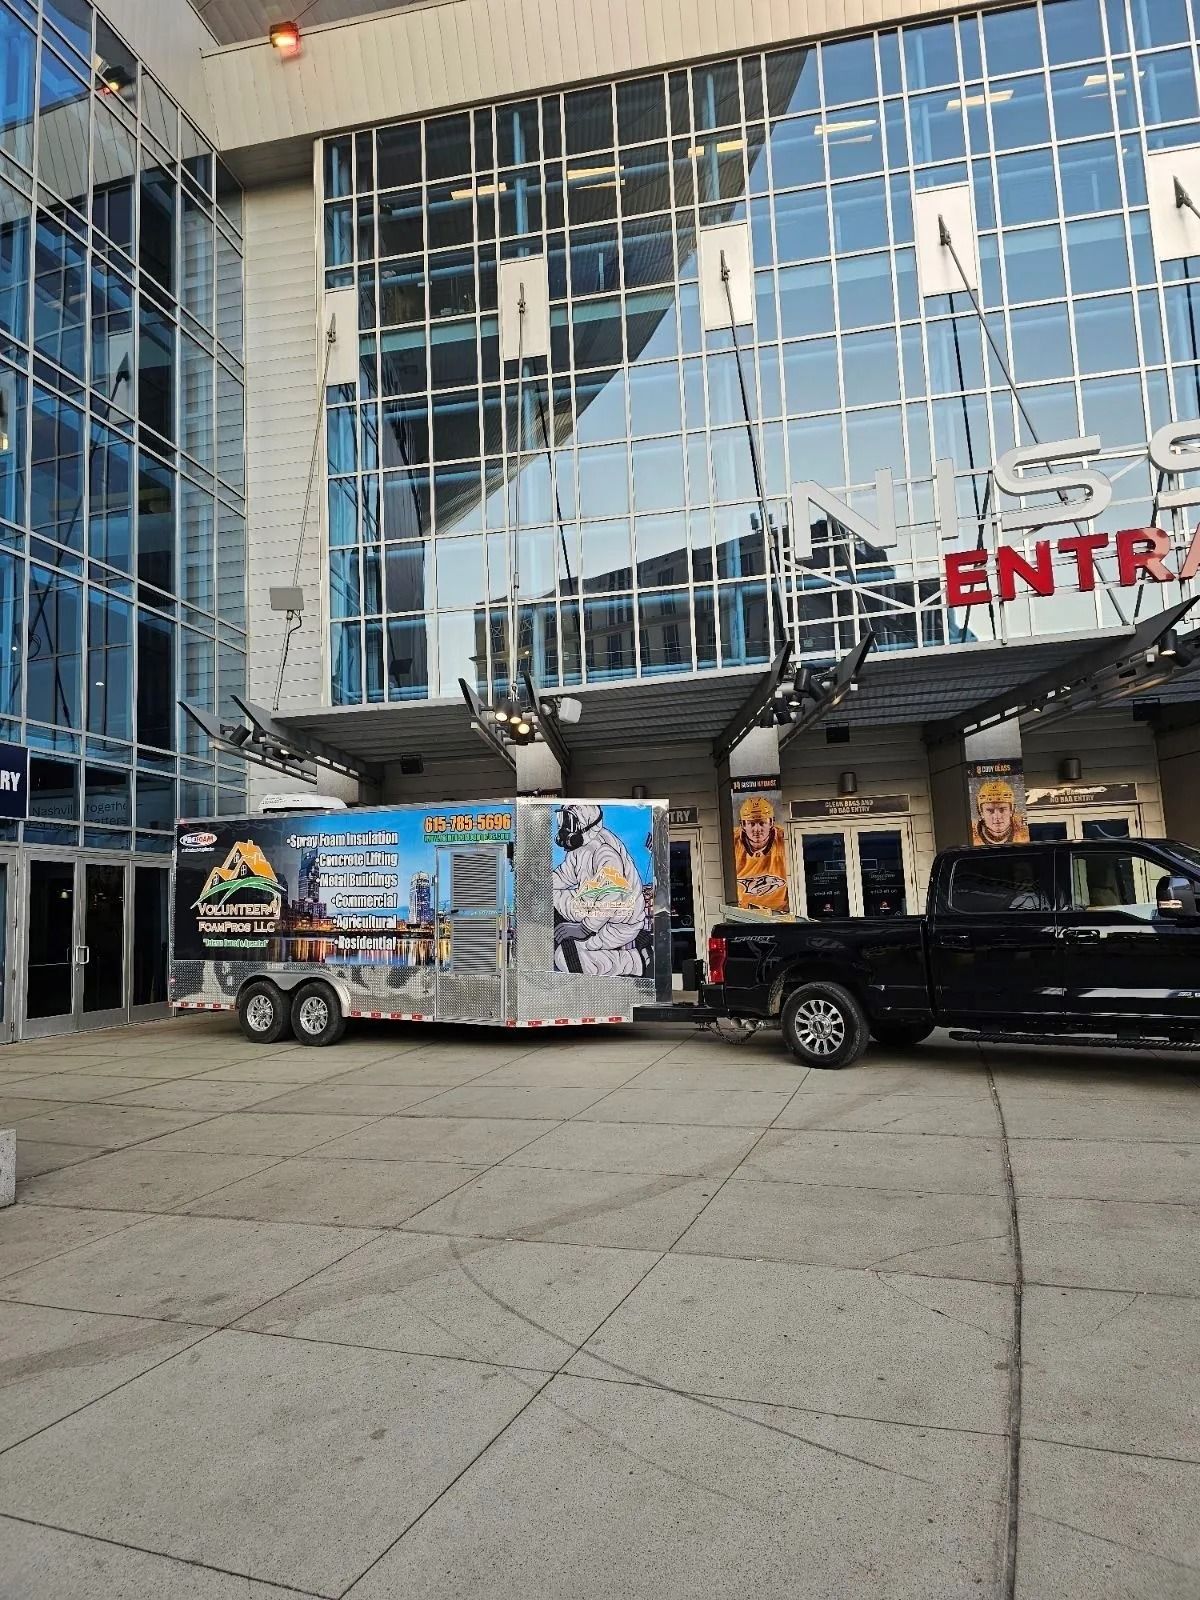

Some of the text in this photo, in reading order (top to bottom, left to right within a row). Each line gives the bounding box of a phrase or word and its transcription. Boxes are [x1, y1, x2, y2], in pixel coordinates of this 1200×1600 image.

[1074, 794, 1095, 802] ENTRY
[851, 805, 870, 813] ENTRY
[425, 813, 511, 833] 615-785-5696
[290, 830, 398, 849] Spray Foam Insulation
[319, 851, 398, 867] Concrete Lifting
[319, 872, 398, 889] Metal Buildings
[335, 893, 398, 908] Commercial
[198, 902, 271, 916] VOLUNTEER
[253, 921, 276, 933] LLC
[336, 914, 397, 929] Agricultural
[338, 936, 397, 950] Residential
